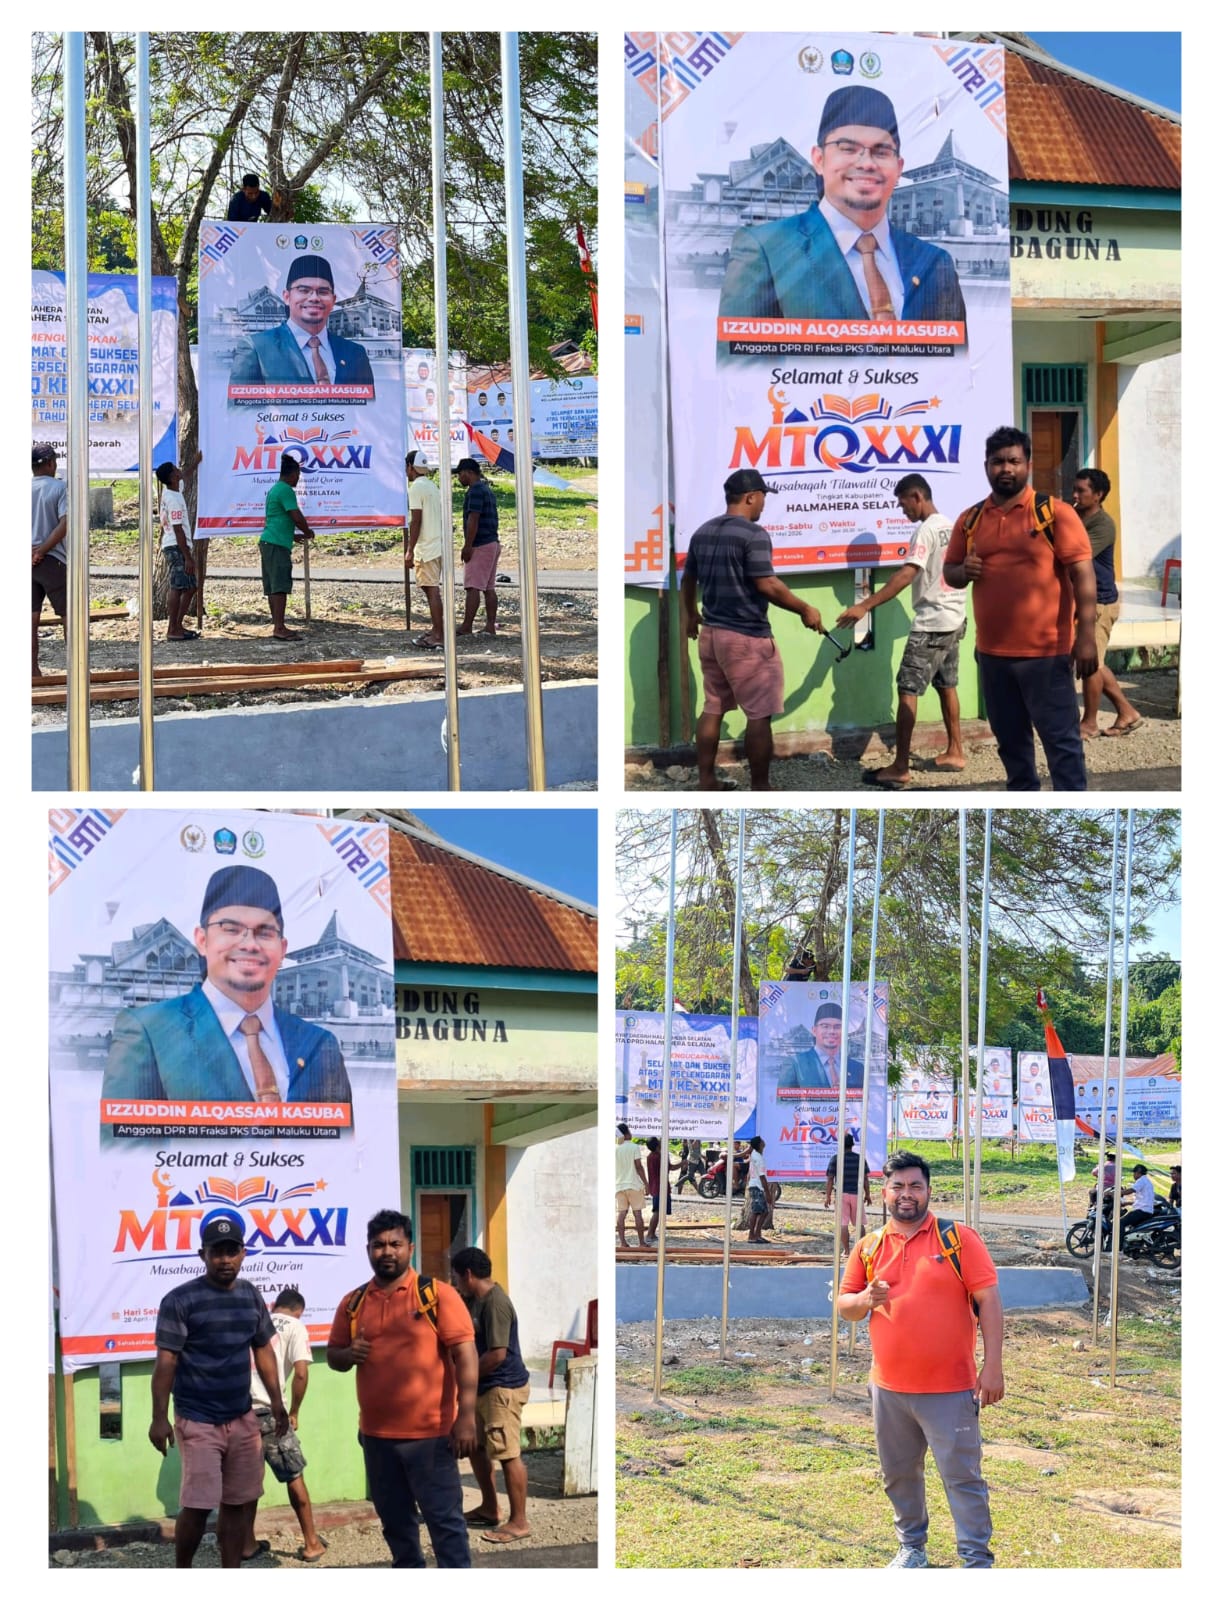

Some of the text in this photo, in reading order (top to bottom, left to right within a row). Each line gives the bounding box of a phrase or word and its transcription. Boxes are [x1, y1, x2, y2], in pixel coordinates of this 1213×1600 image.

[1009, 208, 1094, 234] DUNG
[31, 314, 62, 322] AHERA
[723, 322, 959, 337] IZZUDDIN ALQASSAM KASUBA
[734, 343, 951, 354] Anggota DPR RI Fraksi PKS Dapil Maluku Utara
[770, 368, 843, 384] Selamat
[863, 368, 919, 384] Sukses
[331, 387, 370, 395] KASUBA
[257, 412, 299, 422] Selamat
[311, 412, 345, 422] Sukses
[765, 480, 827, 493] Musabaqah
[830, 478, 877, 490] Tilawatil
[816, 493, 884, 501] Tingkat Kabupaten
[786, 500, 903, 513] HALMAHERA SELATA
[171, 510, 183, 520] 88
[764, 522, 813, 531] elasa-Sabtu
[829, 520, 856, 528] Waktu
[670, 1052, 721, 1060] ENGUCAPKAN
[106, 1103, 344, 1119] IZZUDDIN ALQASSAM KASUBA
[118, 1125, 337, 1138] Anggota DPR RI Fraksi PKS Dapil Maluku Utara
[155, 1151, 229, 1167] Selamat
[249, 1151, 305, 1167] Sukses
[150, 1263, 206, 1276] Musabaqa
[266, 1261, 303, 1274] Qur'an
[256, 1284, 299, 1293] ELATAN
[123, 1308, 141, 1316] Hari
